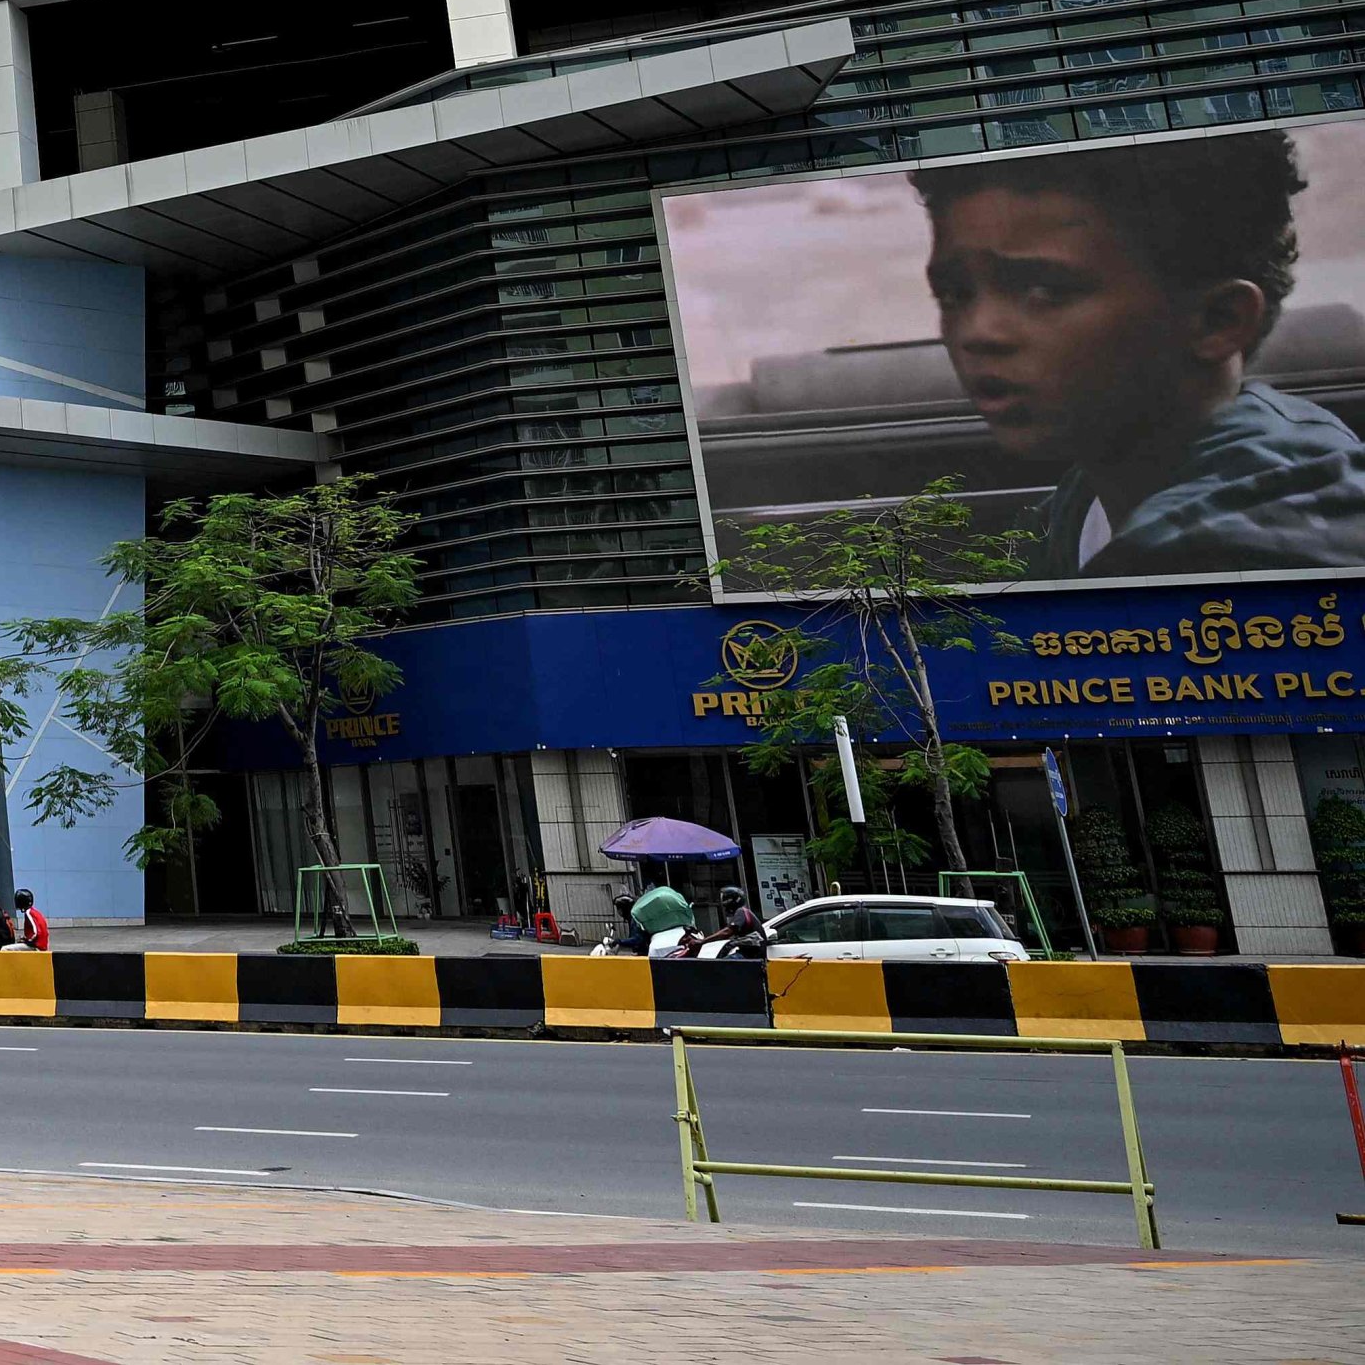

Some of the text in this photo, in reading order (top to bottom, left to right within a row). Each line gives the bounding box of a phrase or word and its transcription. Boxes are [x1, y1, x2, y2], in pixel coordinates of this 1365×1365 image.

[1032, 627, 1172, 657] ធនាគារ
[988, 670, 1365, 706] PRINCE BANK PLC.
[326, 713, 400, 740] PRINCE
